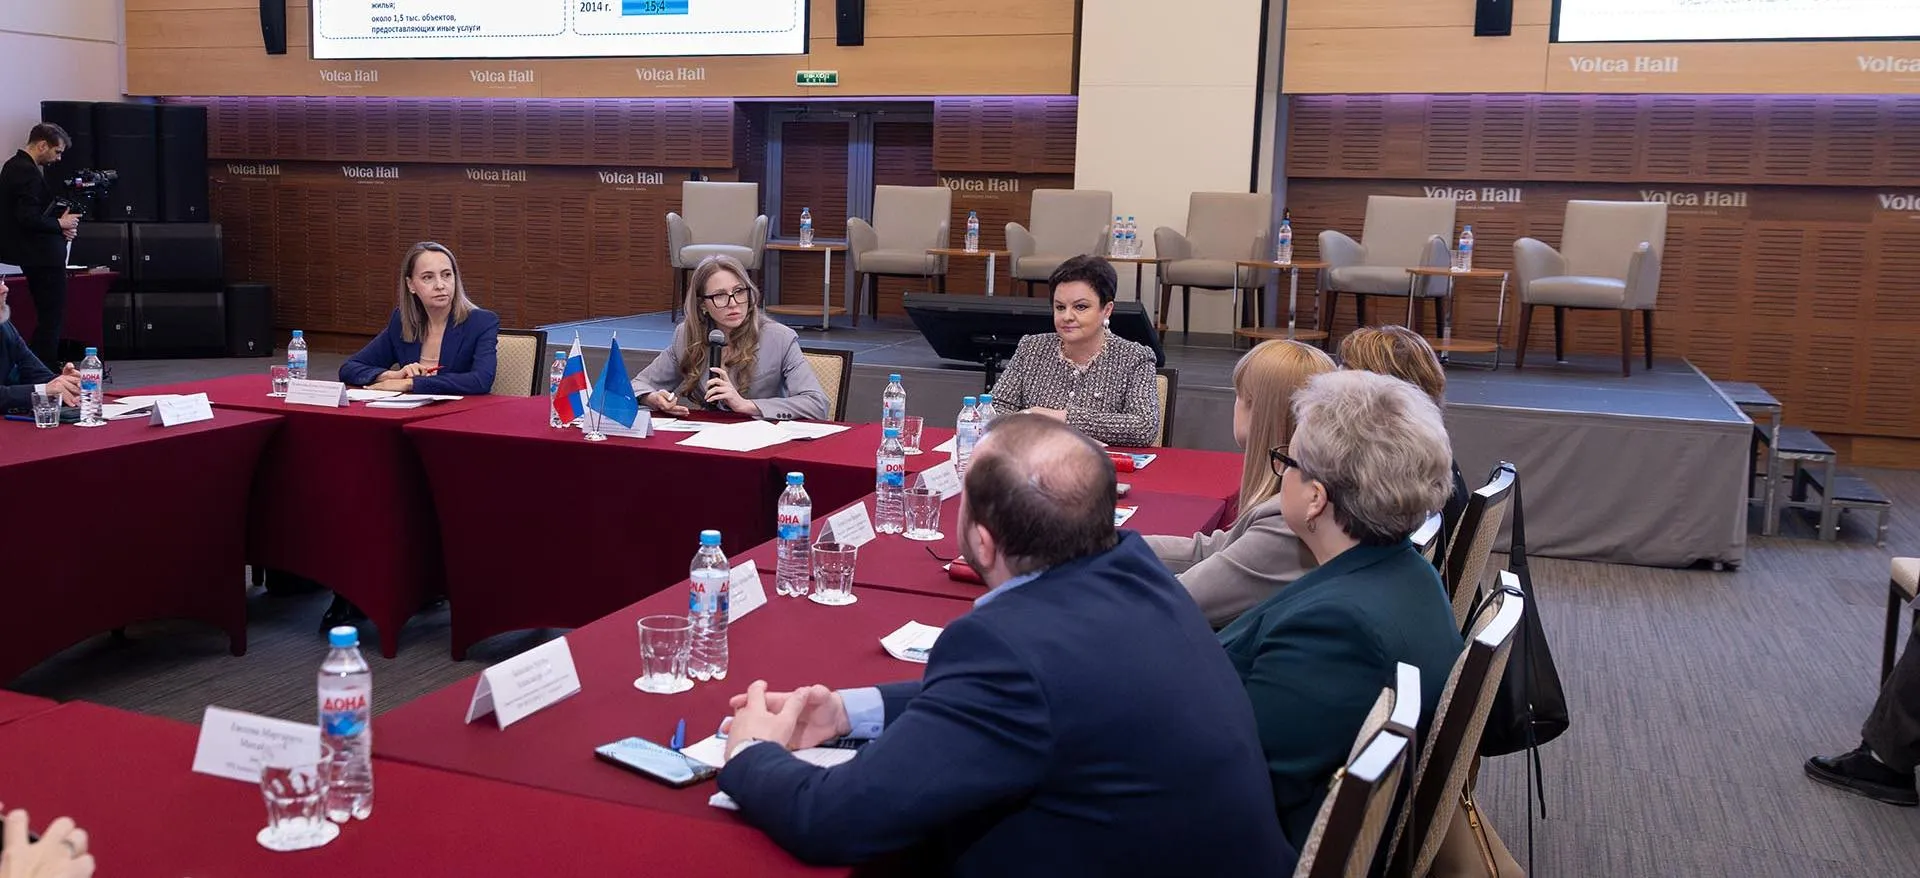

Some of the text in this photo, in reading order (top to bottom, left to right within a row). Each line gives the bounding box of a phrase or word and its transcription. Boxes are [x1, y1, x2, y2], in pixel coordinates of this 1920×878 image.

[580, 2, 603, 12] 2014
[645, 1, 665, 14] 15,4
[393, 14, 404, 23] 1,5
[422, 13, 457, 22] объектов,
[371, 26, 435, 34] предоставляющих
[457, 25, 481, 33] услуги
[1633, 57, 1679, 72] Hall
[354, 70, 379, 82] Hall
[508, 70, 535, 83] Hall
[677, 68, 706, 81] Hall
[258, 164, 280, 176] Hall
[376, 167, 399, 179] Hall
[501, 170, 527, 182] Hall
[637, 172, 664, 185] Hall
[988, 178, 1019, 192] Hall
[1480, 188, 1521, 203] Hall
[1703, 191, 1748, 207] Hall
[778, 514, 800, 524] ОНА
[324, 694, 367, 711] ДОНА
